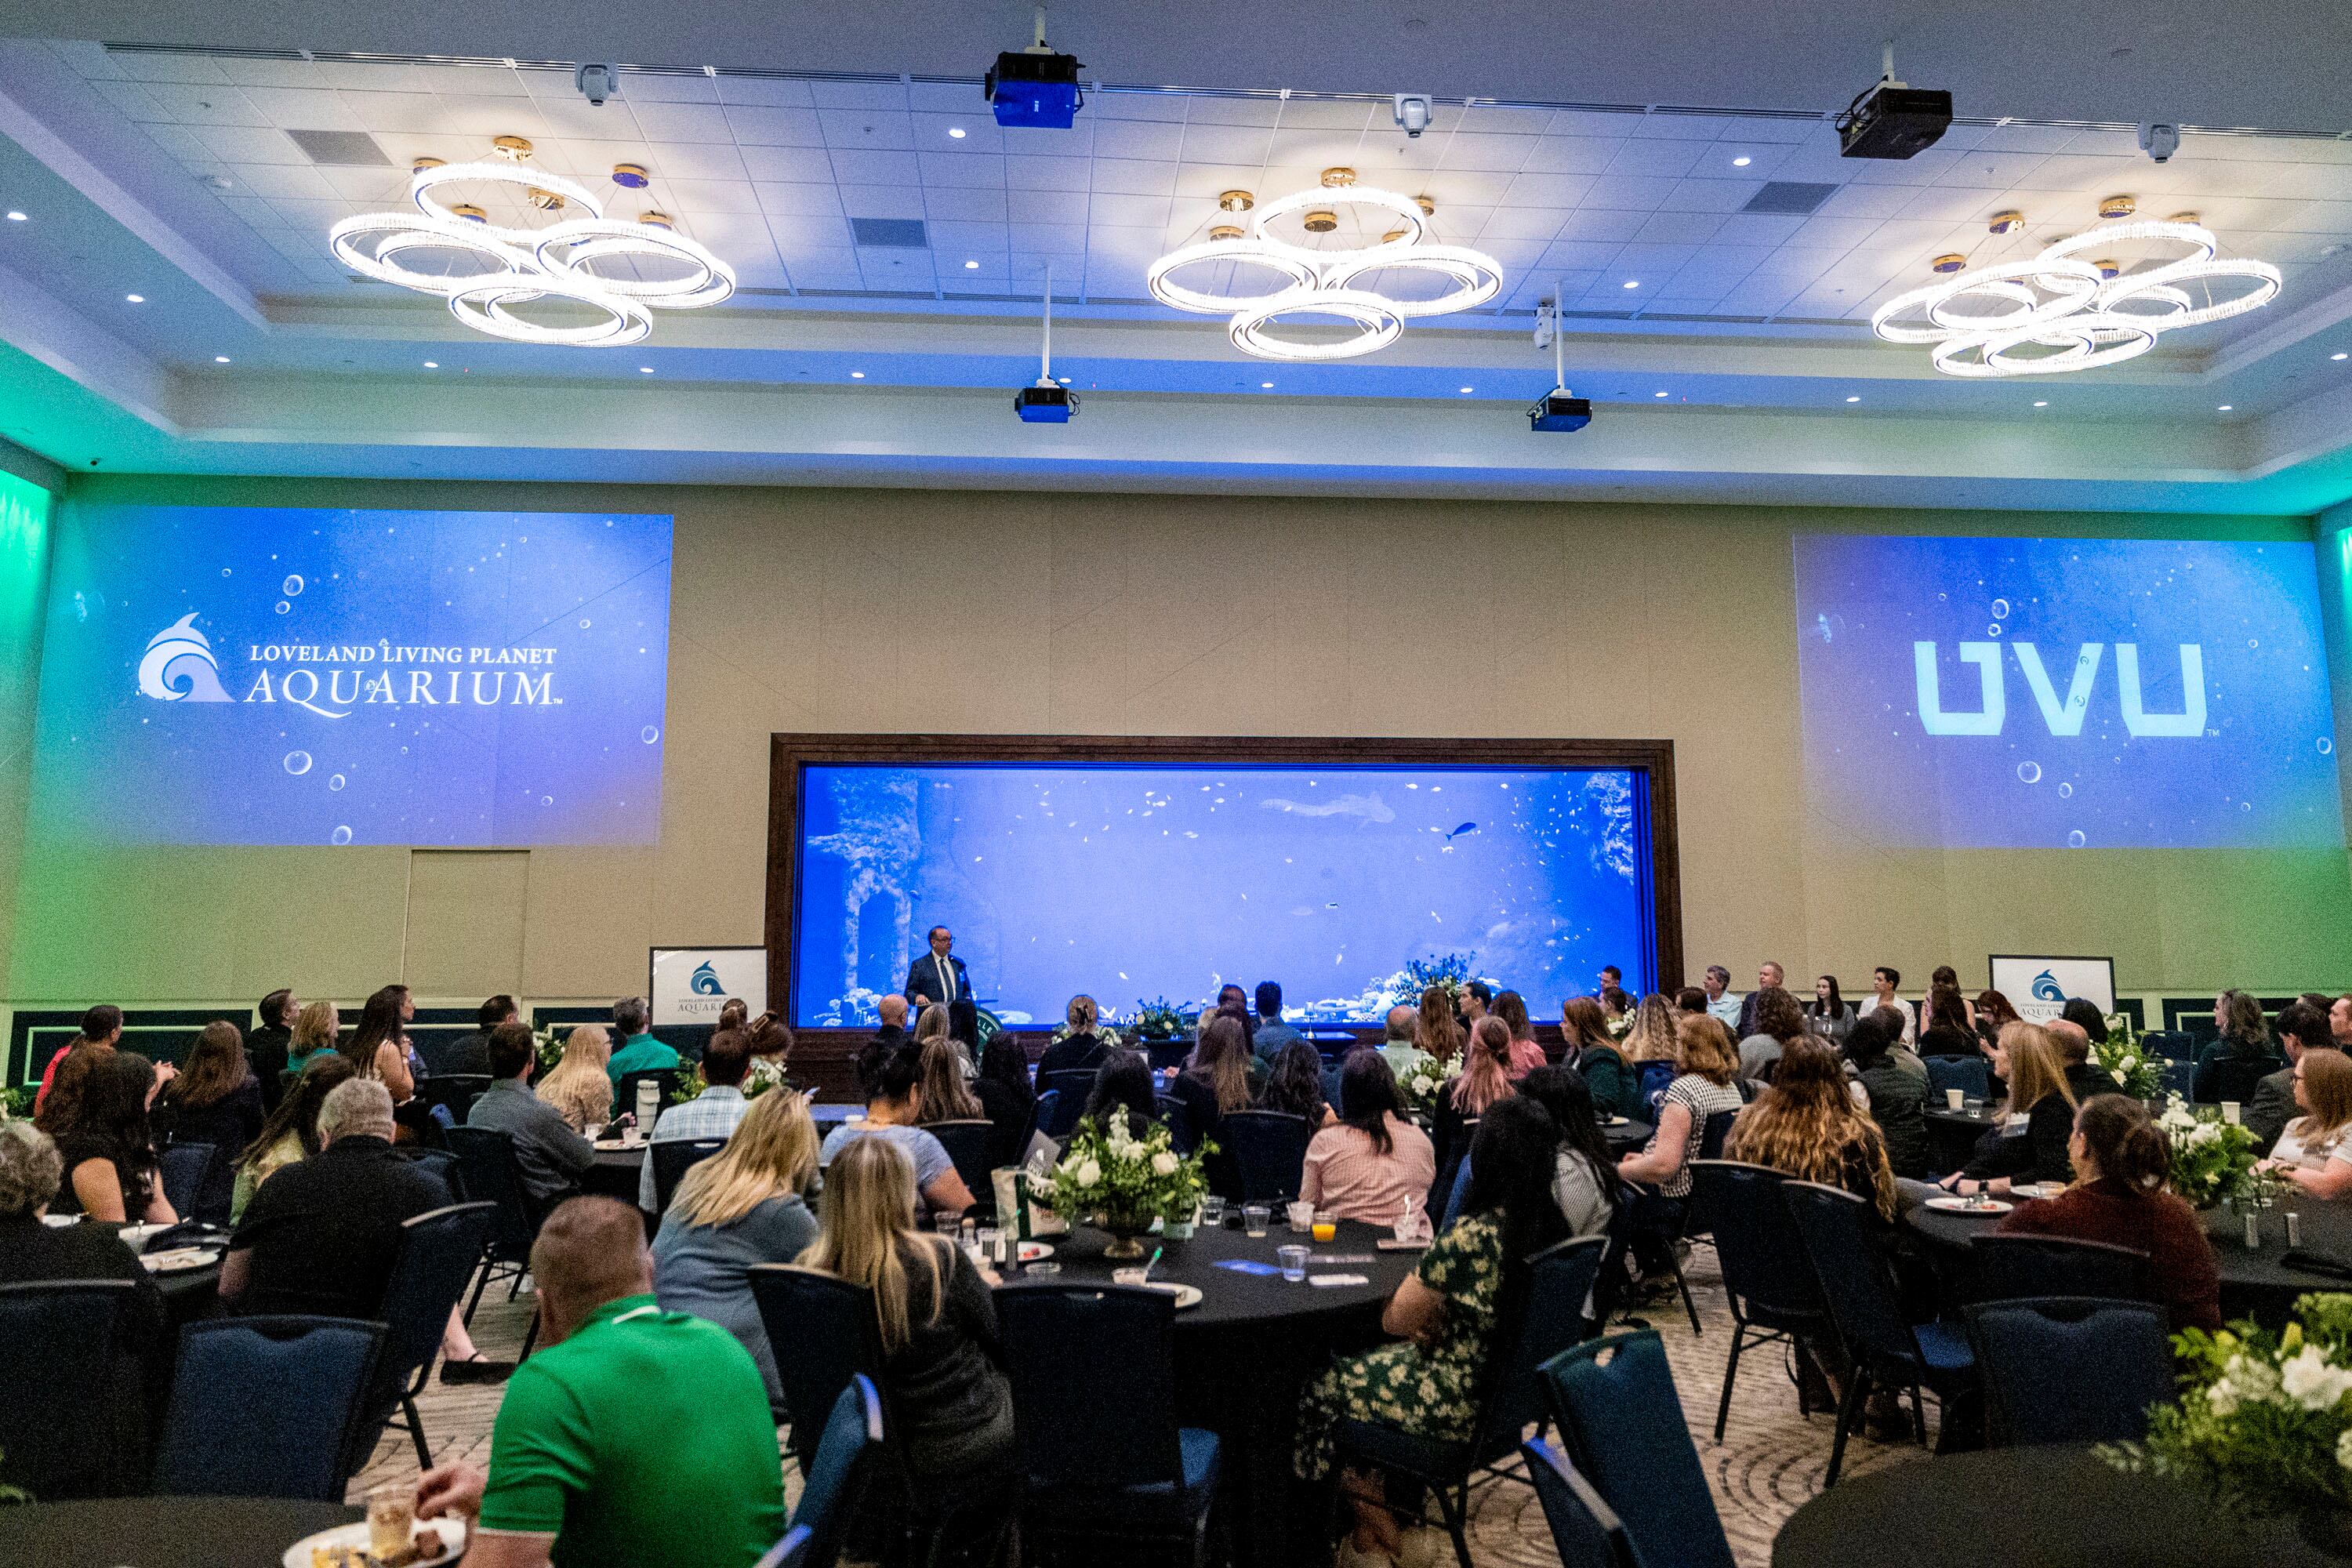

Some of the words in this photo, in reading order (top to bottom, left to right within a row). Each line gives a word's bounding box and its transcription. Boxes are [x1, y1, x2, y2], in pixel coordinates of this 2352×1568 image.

[249, 645, 376, 662] LOVELAND
[382, 646, 463, 662] LIVING
[469, 648, 557, 664] PLANET
[242, 667, 555, 719] AQUARIUM
[1914, 641, 2208, 737] UVU
[677, 1003, 721, 1014] AQUARI
[2020, 1008, 2060, 1018] AQUAR
